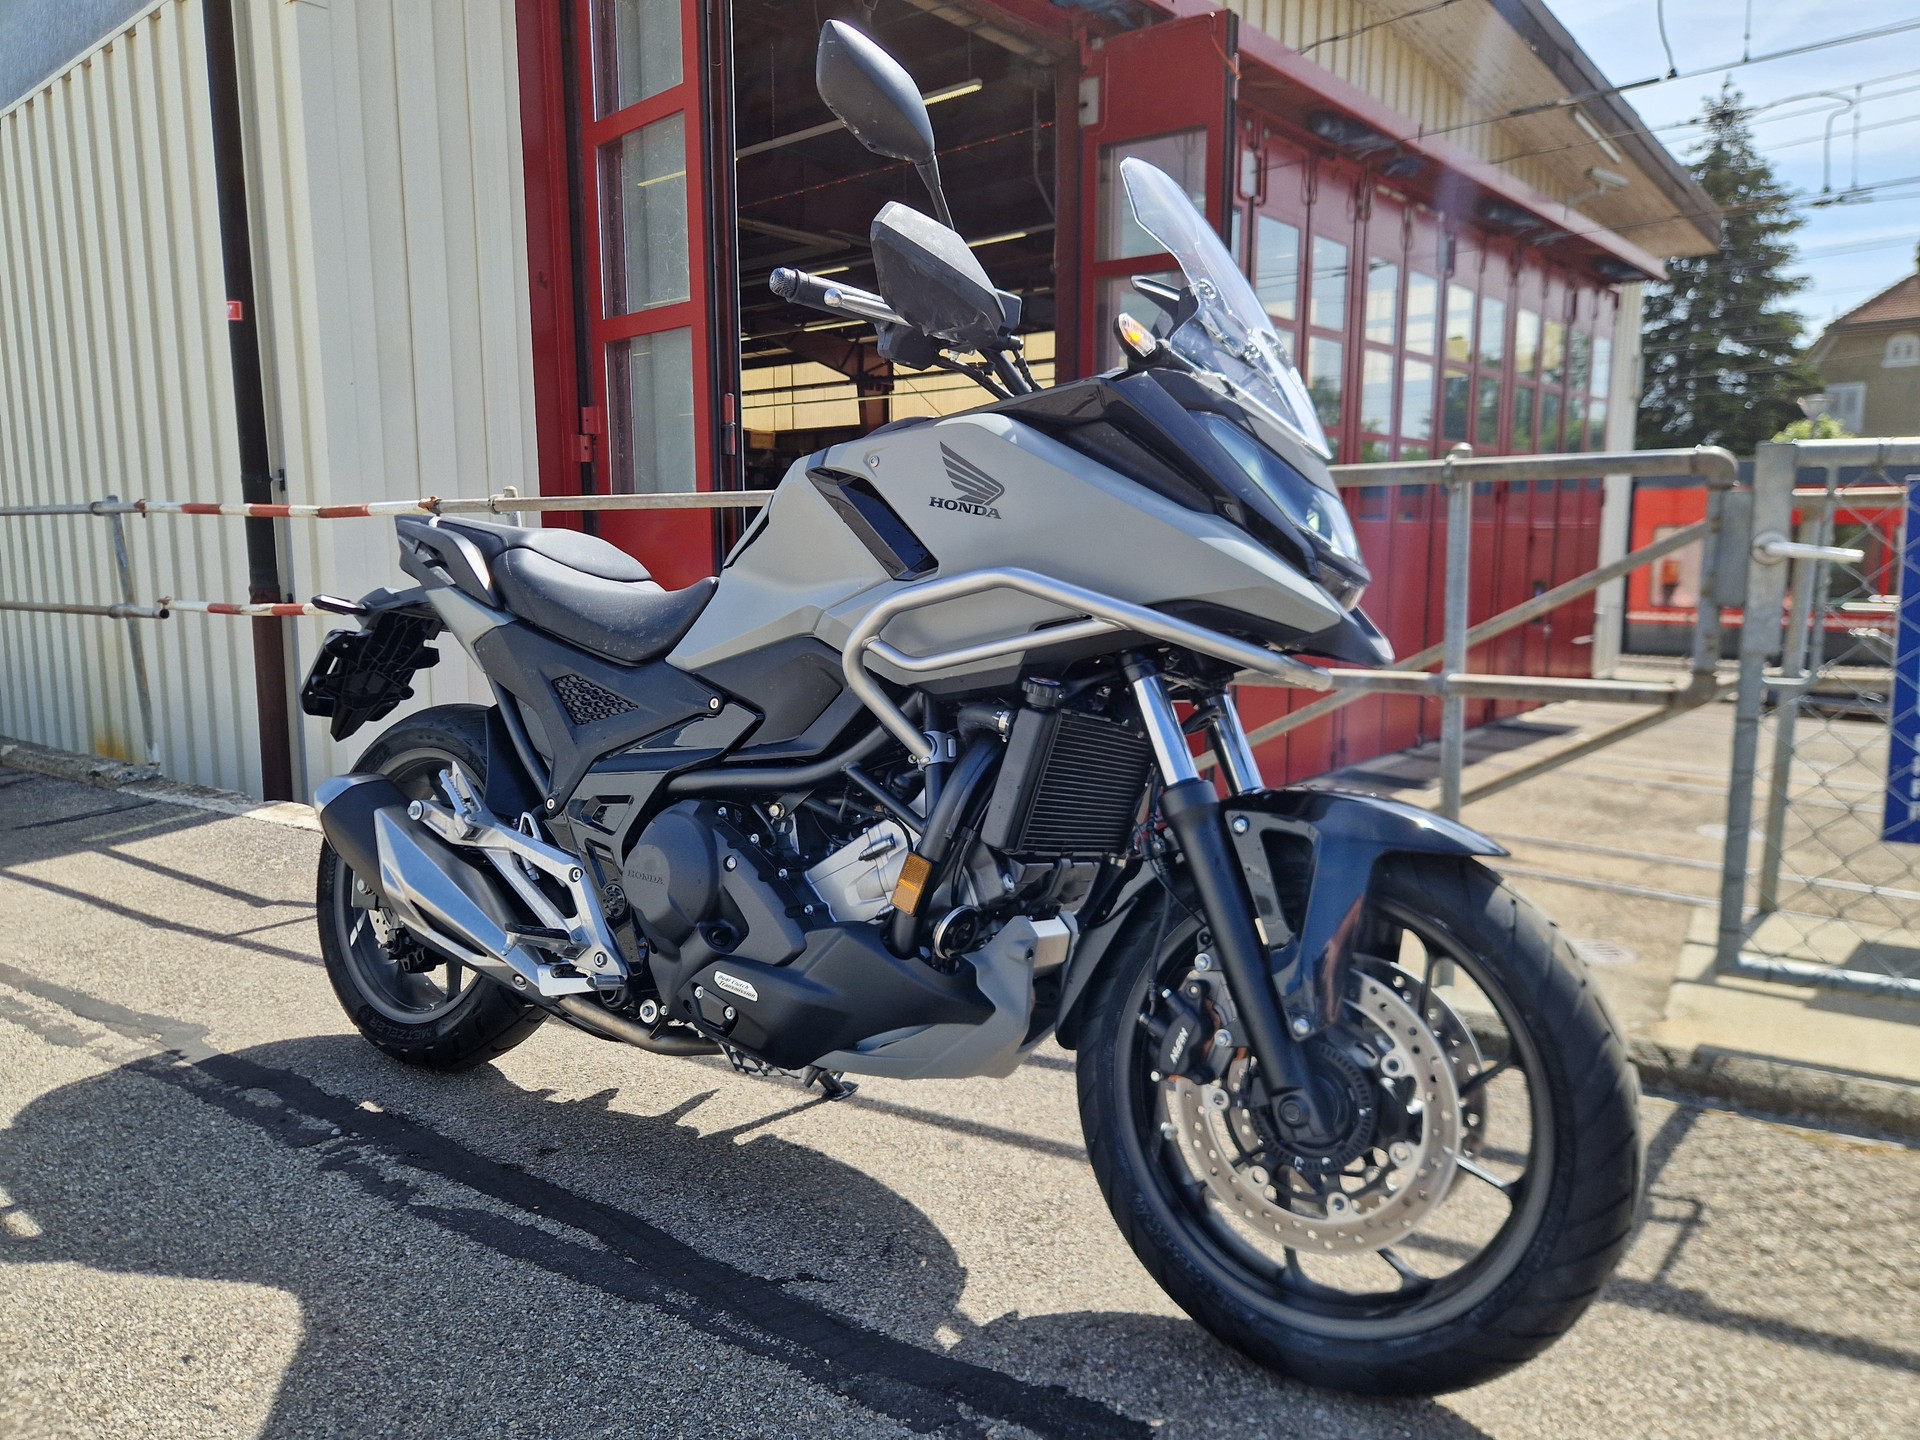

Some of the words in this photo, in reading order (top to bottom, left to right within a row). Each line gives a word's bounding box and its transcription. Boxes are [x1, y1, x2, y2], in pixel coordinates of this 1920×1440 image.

[928, 496, 1002, 519] HONDA
[627, 869, 665, 886] HONDA
[718, 974, 731, 983] Dual
[731, 978, 749, 989] Clutch
[719, 981, 756, 998] Transmission
[369, 1017, 432, 1040] METZELER
